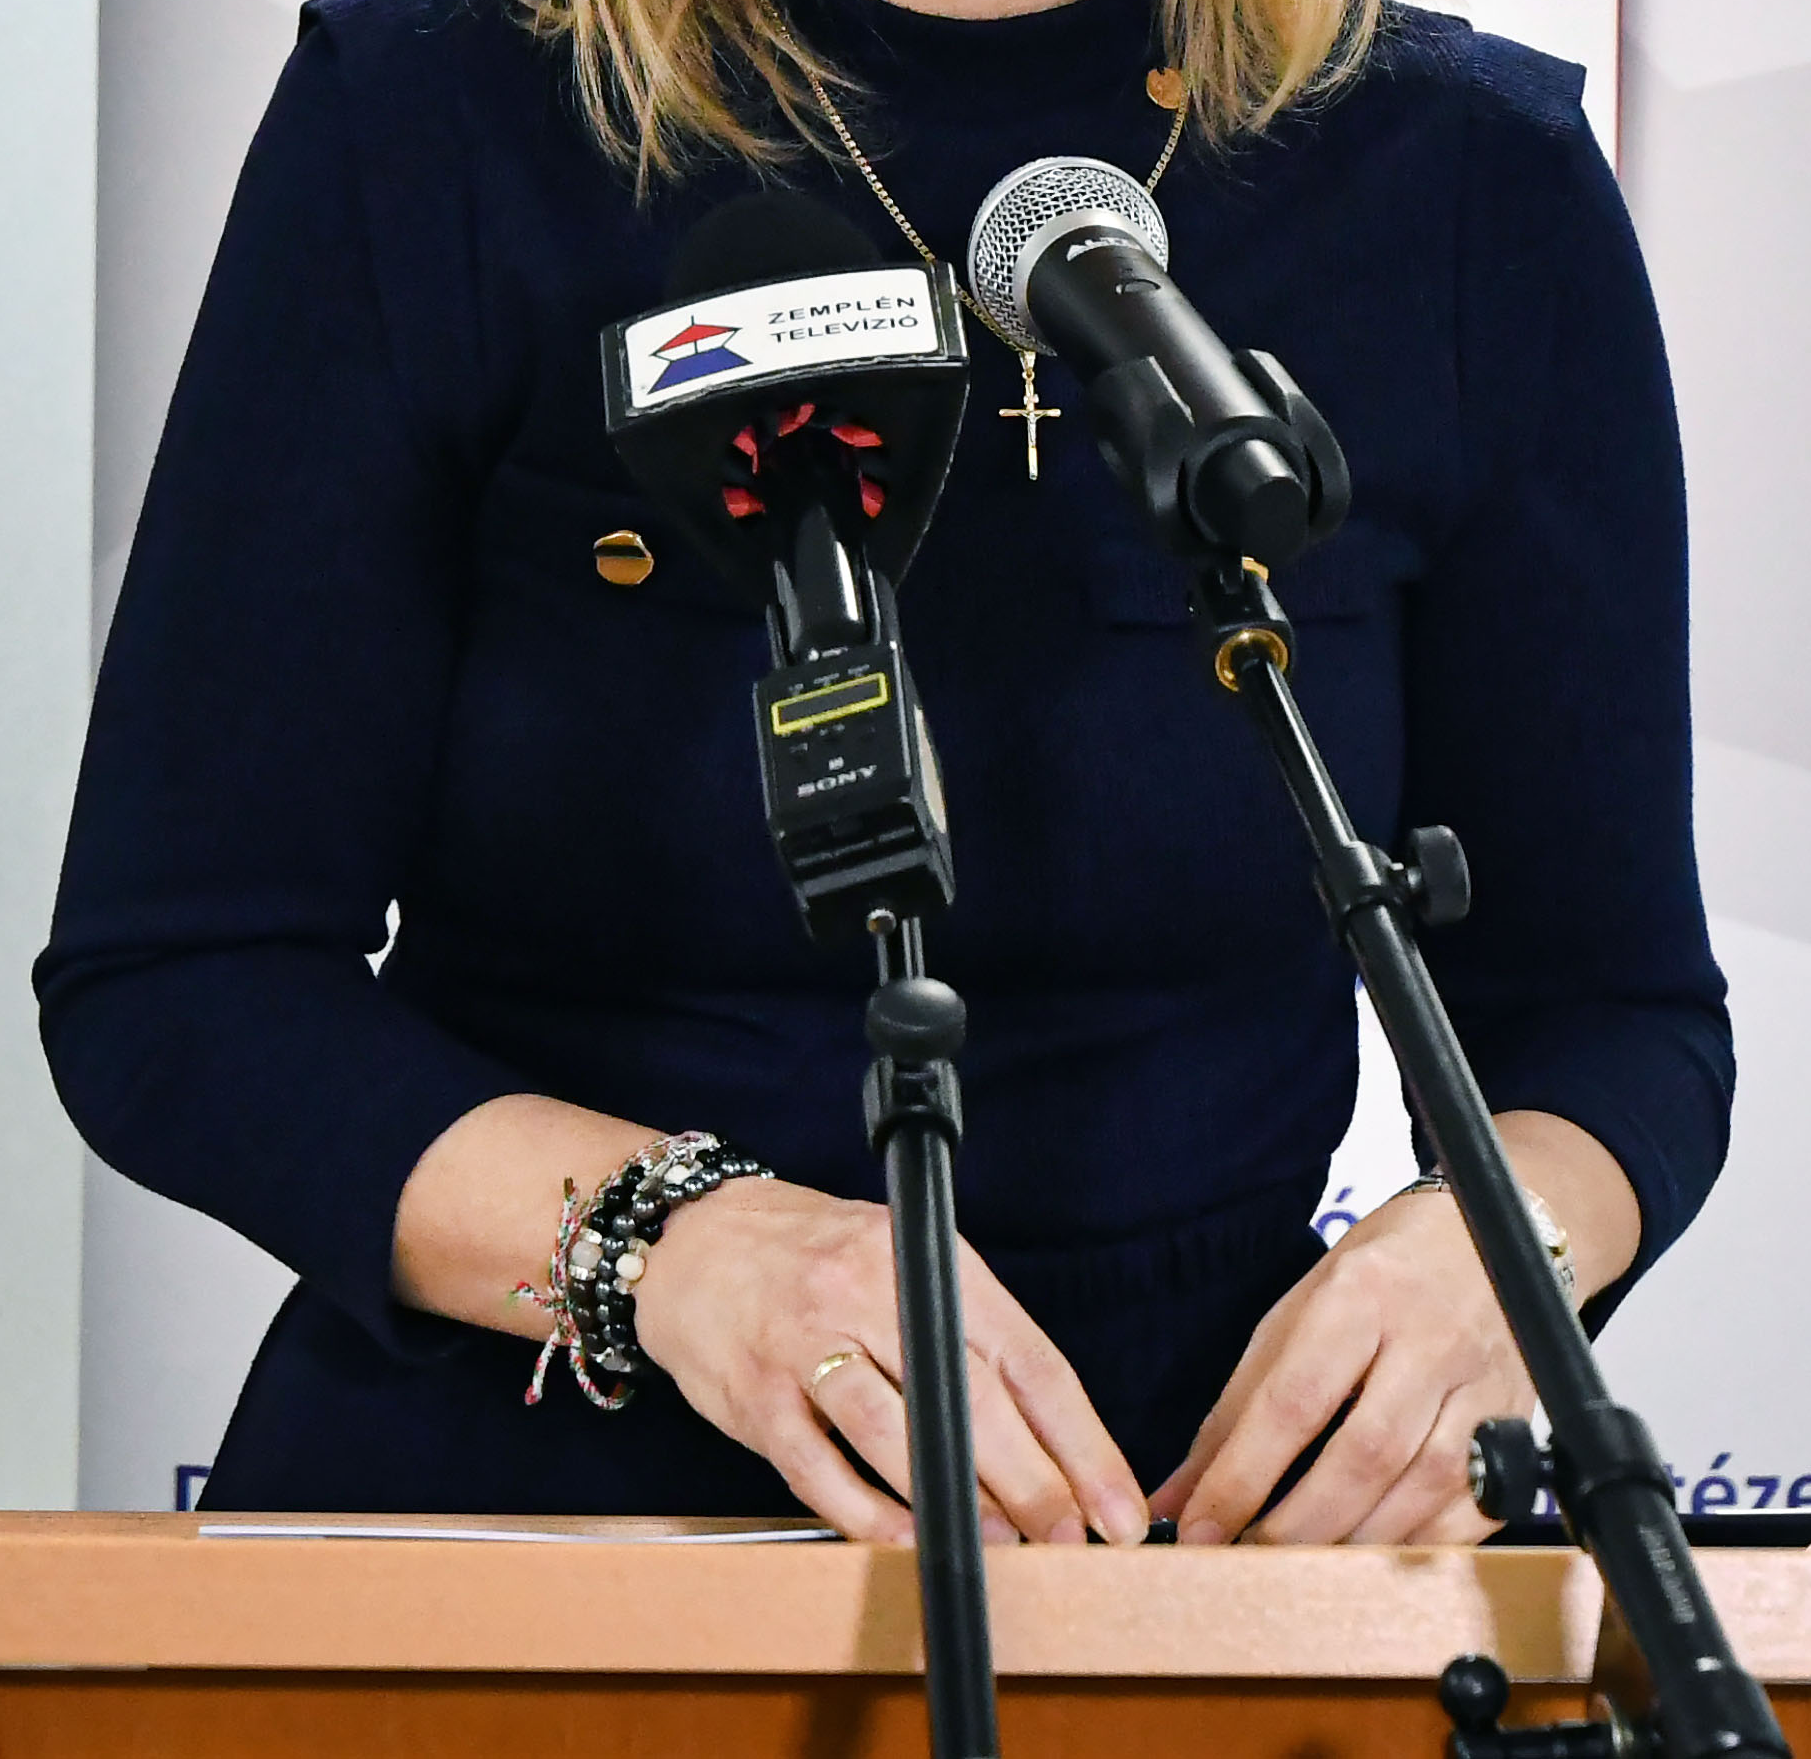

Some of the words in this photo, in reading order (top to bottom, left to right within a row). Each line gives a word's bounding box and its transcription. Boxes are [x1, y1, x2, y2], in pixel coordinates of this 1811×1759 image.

[768, 296, 915, 325] ZEMPLÉN
[770, 314, 919, 343] TELEVÍZIÓ
[797, 764, 877, 798] SONY
